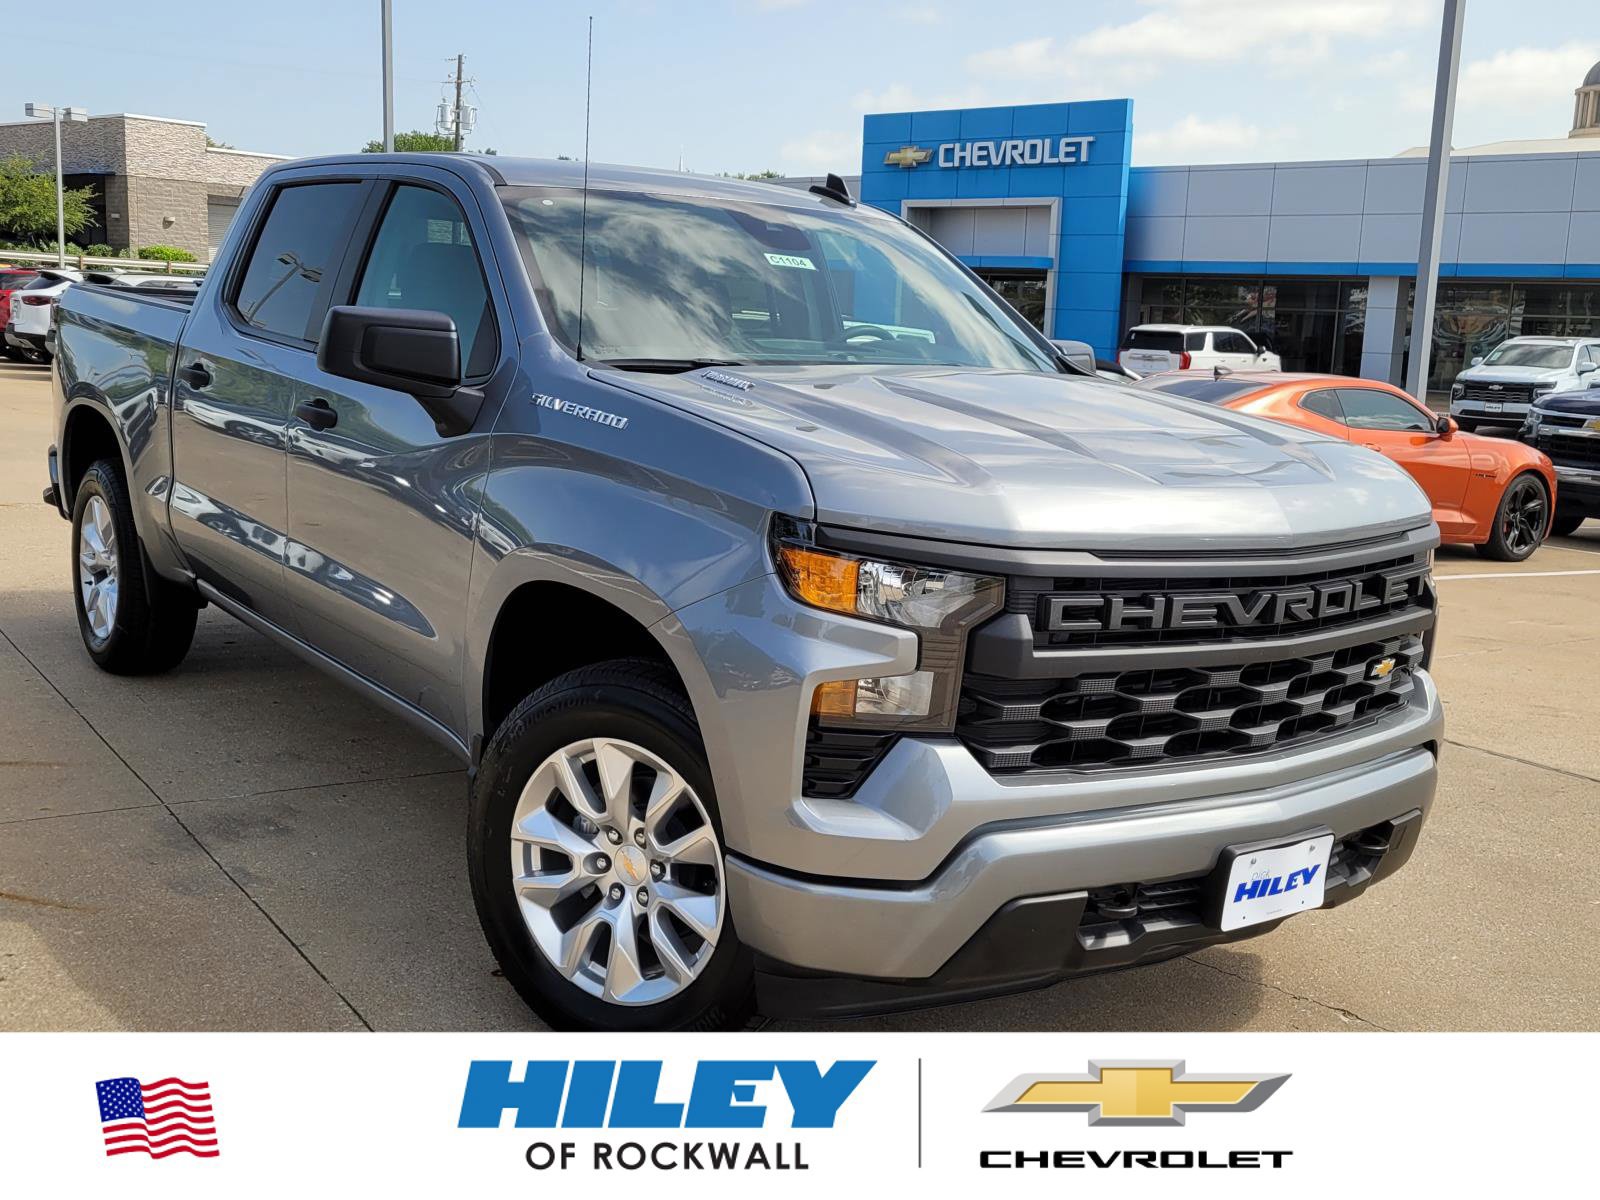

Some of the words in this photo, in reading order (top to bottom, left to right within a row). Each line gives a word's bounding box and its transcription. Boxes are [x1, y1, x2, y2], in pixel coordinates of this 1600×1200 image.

[938, 136, 1095, 168] CHEVROLET
[530, 392, 629, 430] SILVERADO
[1044, 566, 1432, 631] CHEVROLET
[1233, 864, 1321, 903] HILEY
